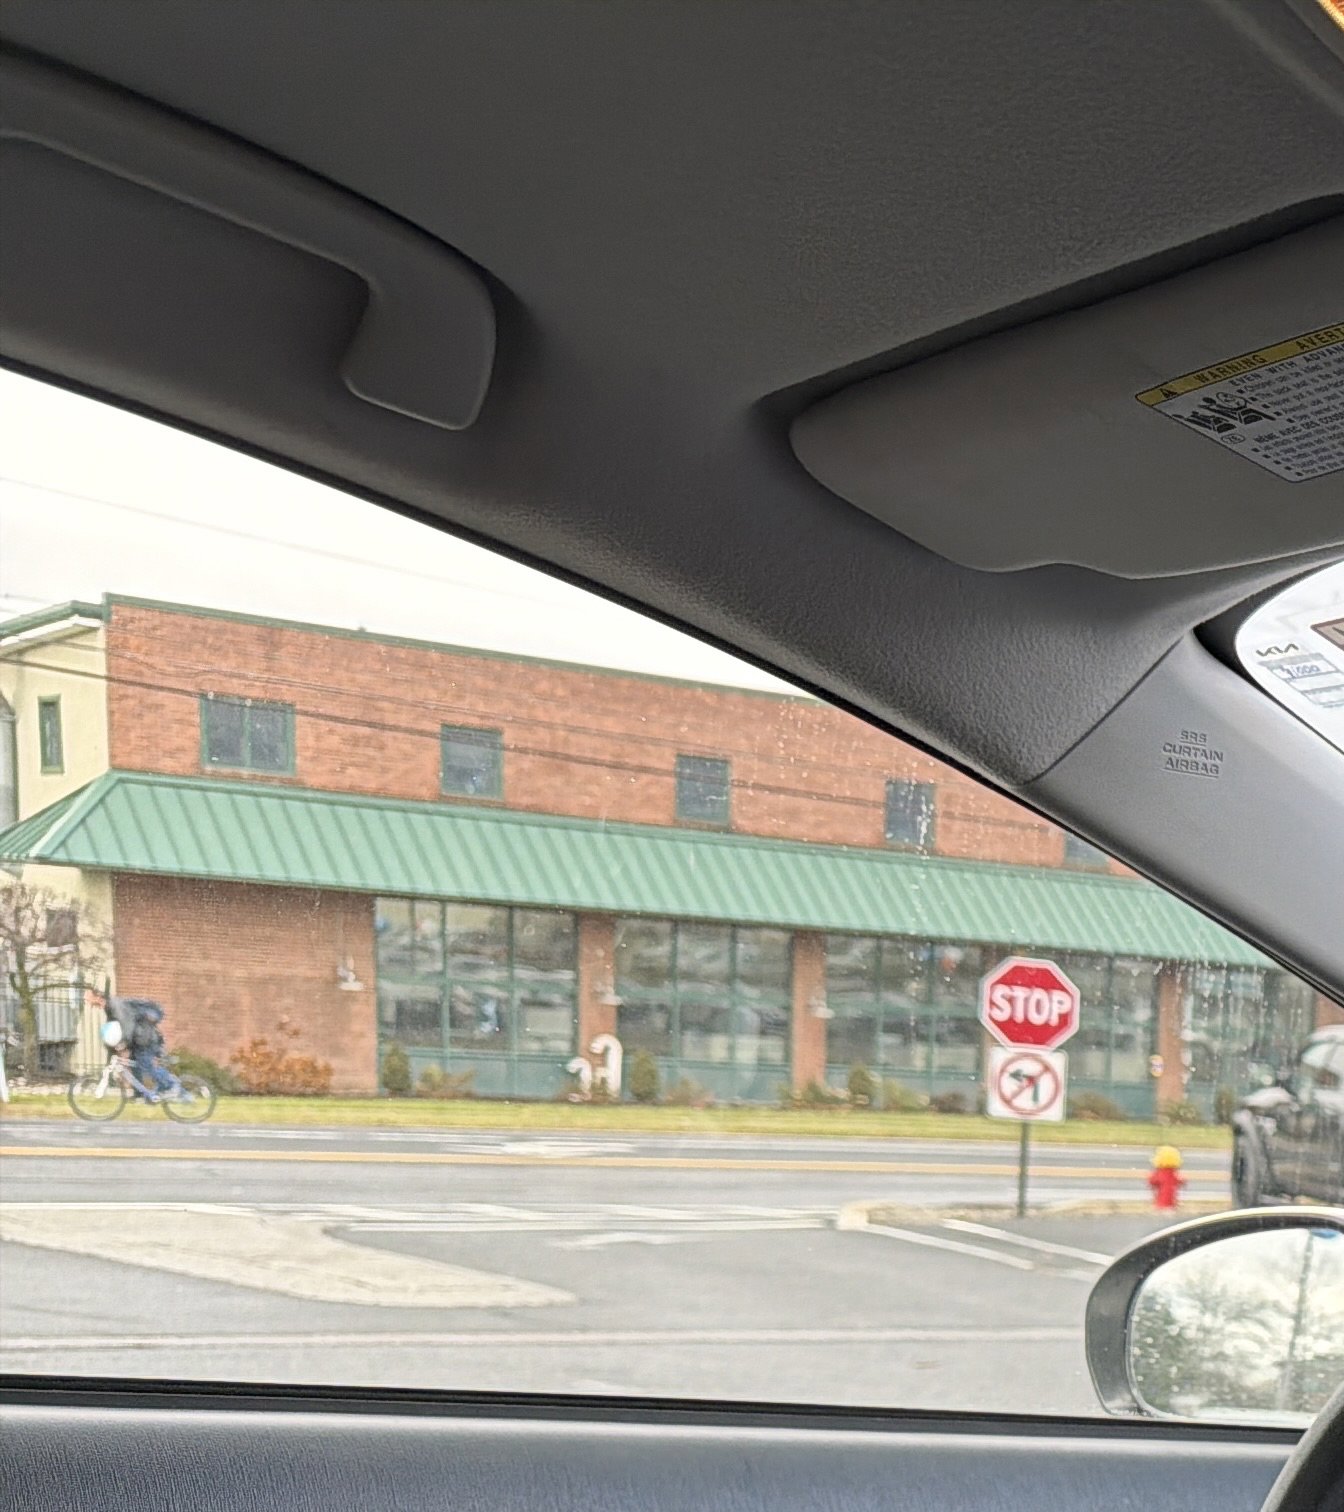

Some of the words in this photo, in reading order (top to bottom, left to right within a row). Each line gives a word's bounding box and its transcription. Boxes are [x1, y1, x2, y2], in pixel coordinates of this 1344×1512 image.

[1193, 354, 1268, 384] WARNING
[1267, 360, 1297, 375] WITH
[1180, 729, 1207, 743] SRS
[1162, 742, 1223, 762] CURTAIN
[1166, 757, 1219, 775] AIRBAG
[989, 984, 1073, 1027] STOP
